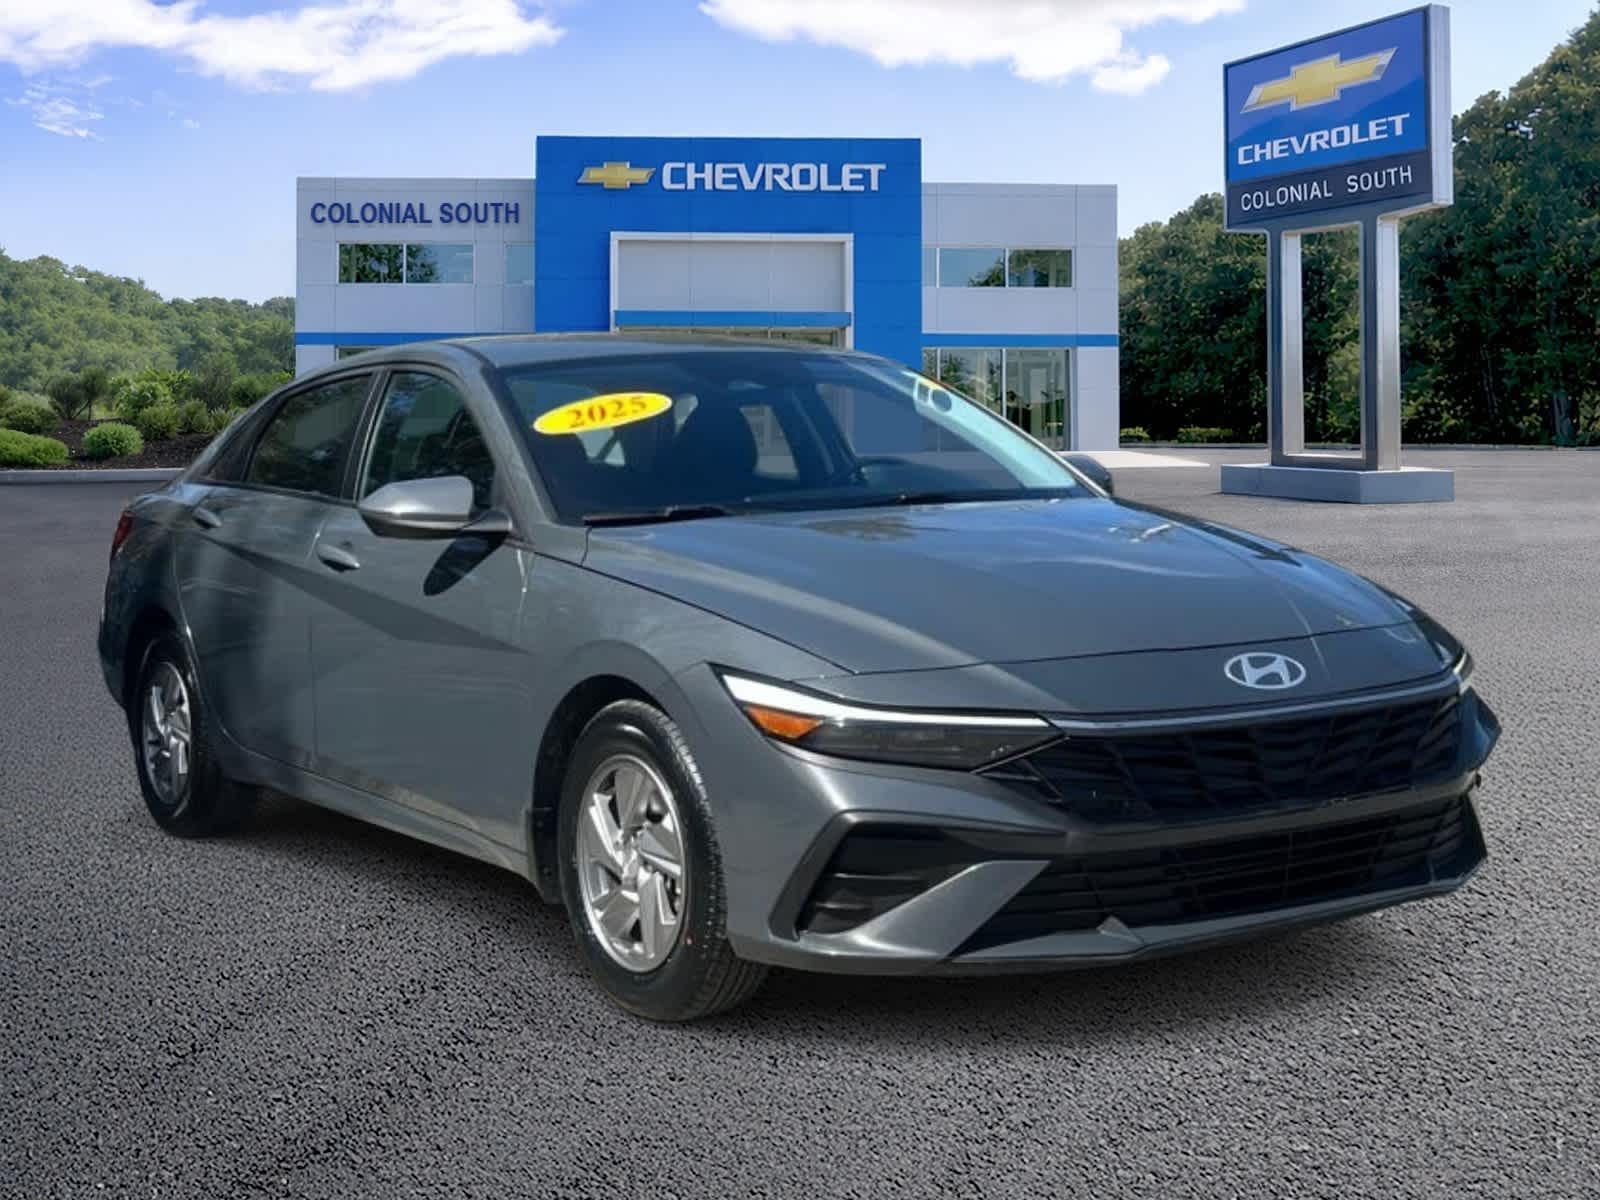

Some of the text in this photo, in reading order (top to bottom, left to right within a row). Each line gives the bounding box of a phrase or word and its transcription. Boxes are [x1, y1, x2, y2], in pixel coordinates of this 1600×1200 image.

[1238, 113, 1410, 165] CHEVROLET
[662, 162, 887, 191] CHEVROLET
[1241, 165, 1412, 211] COLONIAL SOUTH
[310, 202, 520, 224] COLONIAL SOUTH
[567, 396, 648, 428] 2025
